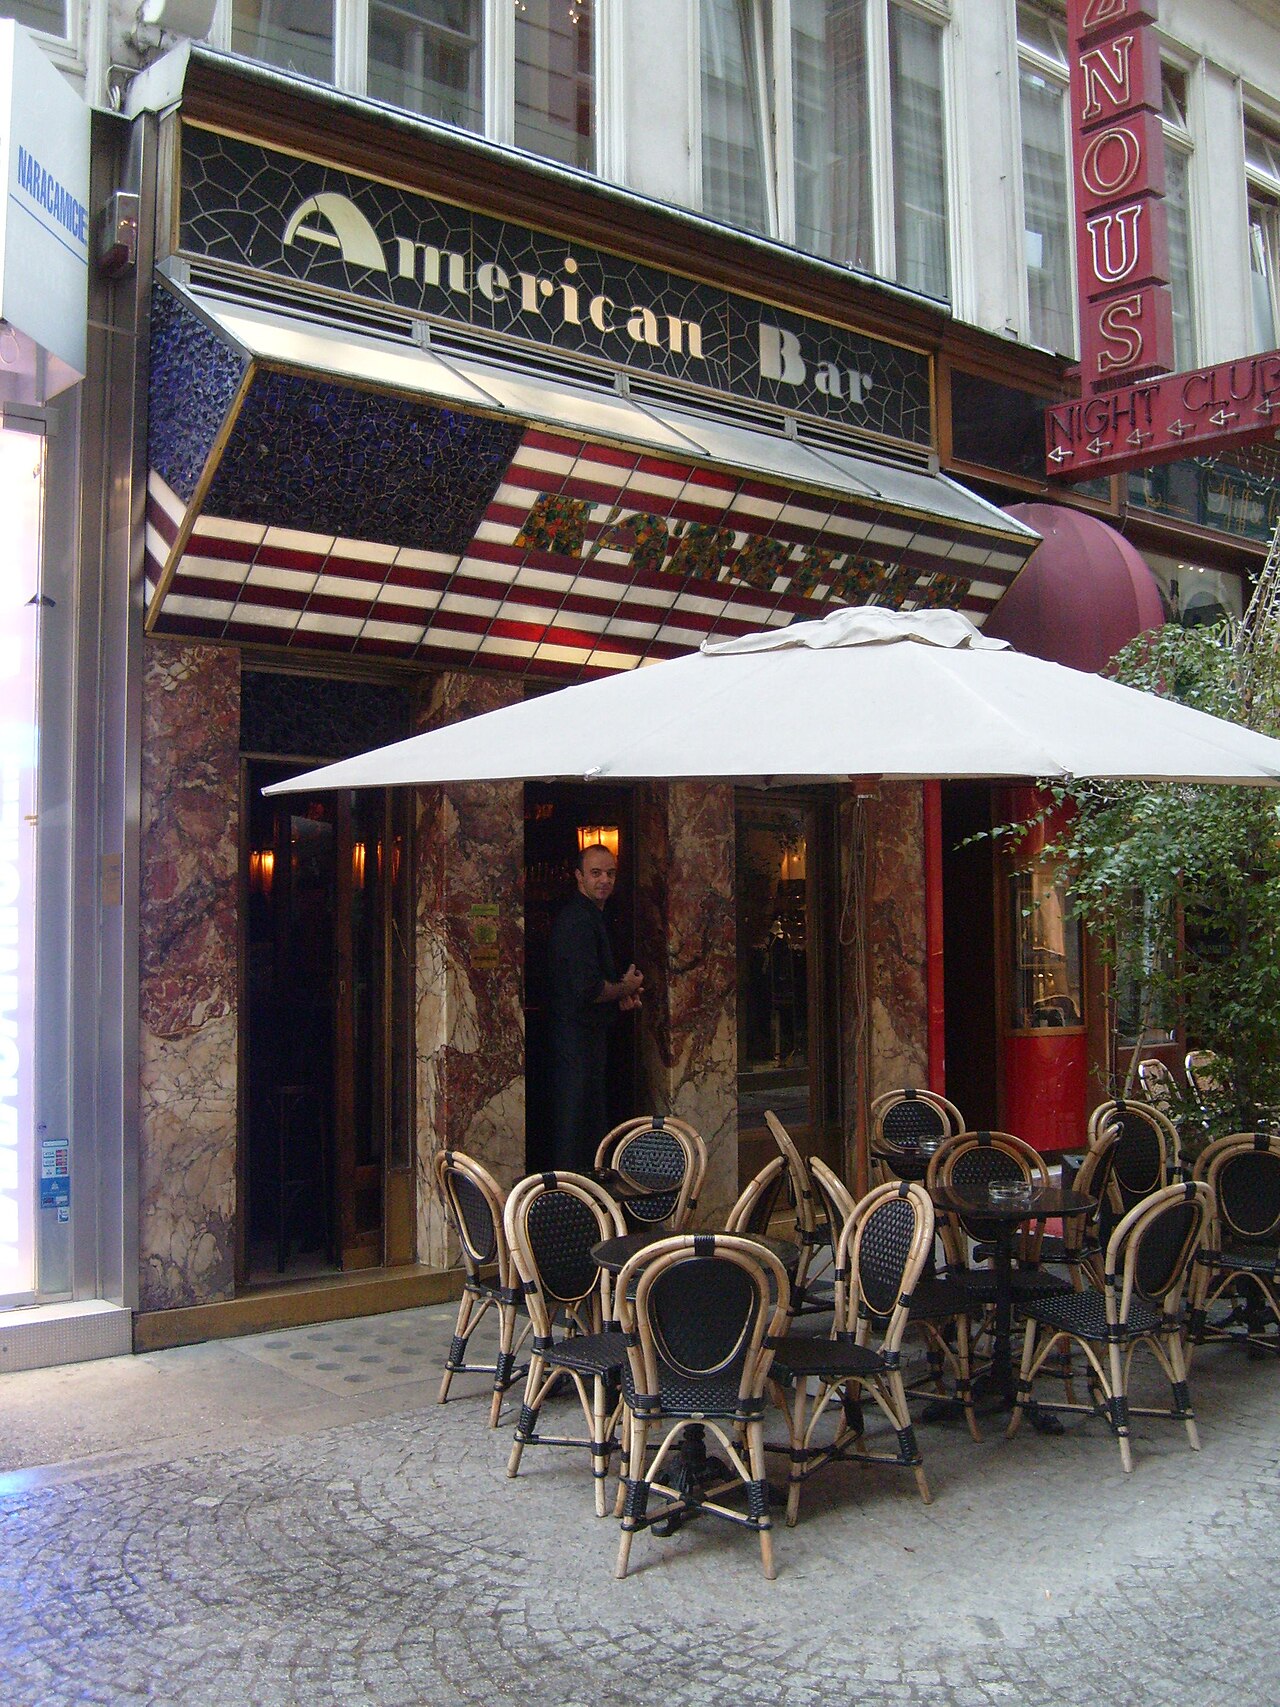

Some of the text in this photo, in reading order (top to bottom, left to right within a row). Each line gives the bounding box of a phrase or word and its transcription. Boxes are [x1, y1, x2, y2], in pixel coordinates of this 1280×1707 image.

[284, 192, 873, 405] American Bar
[1050, 355, 1280, 447] NIGHT CLUB
